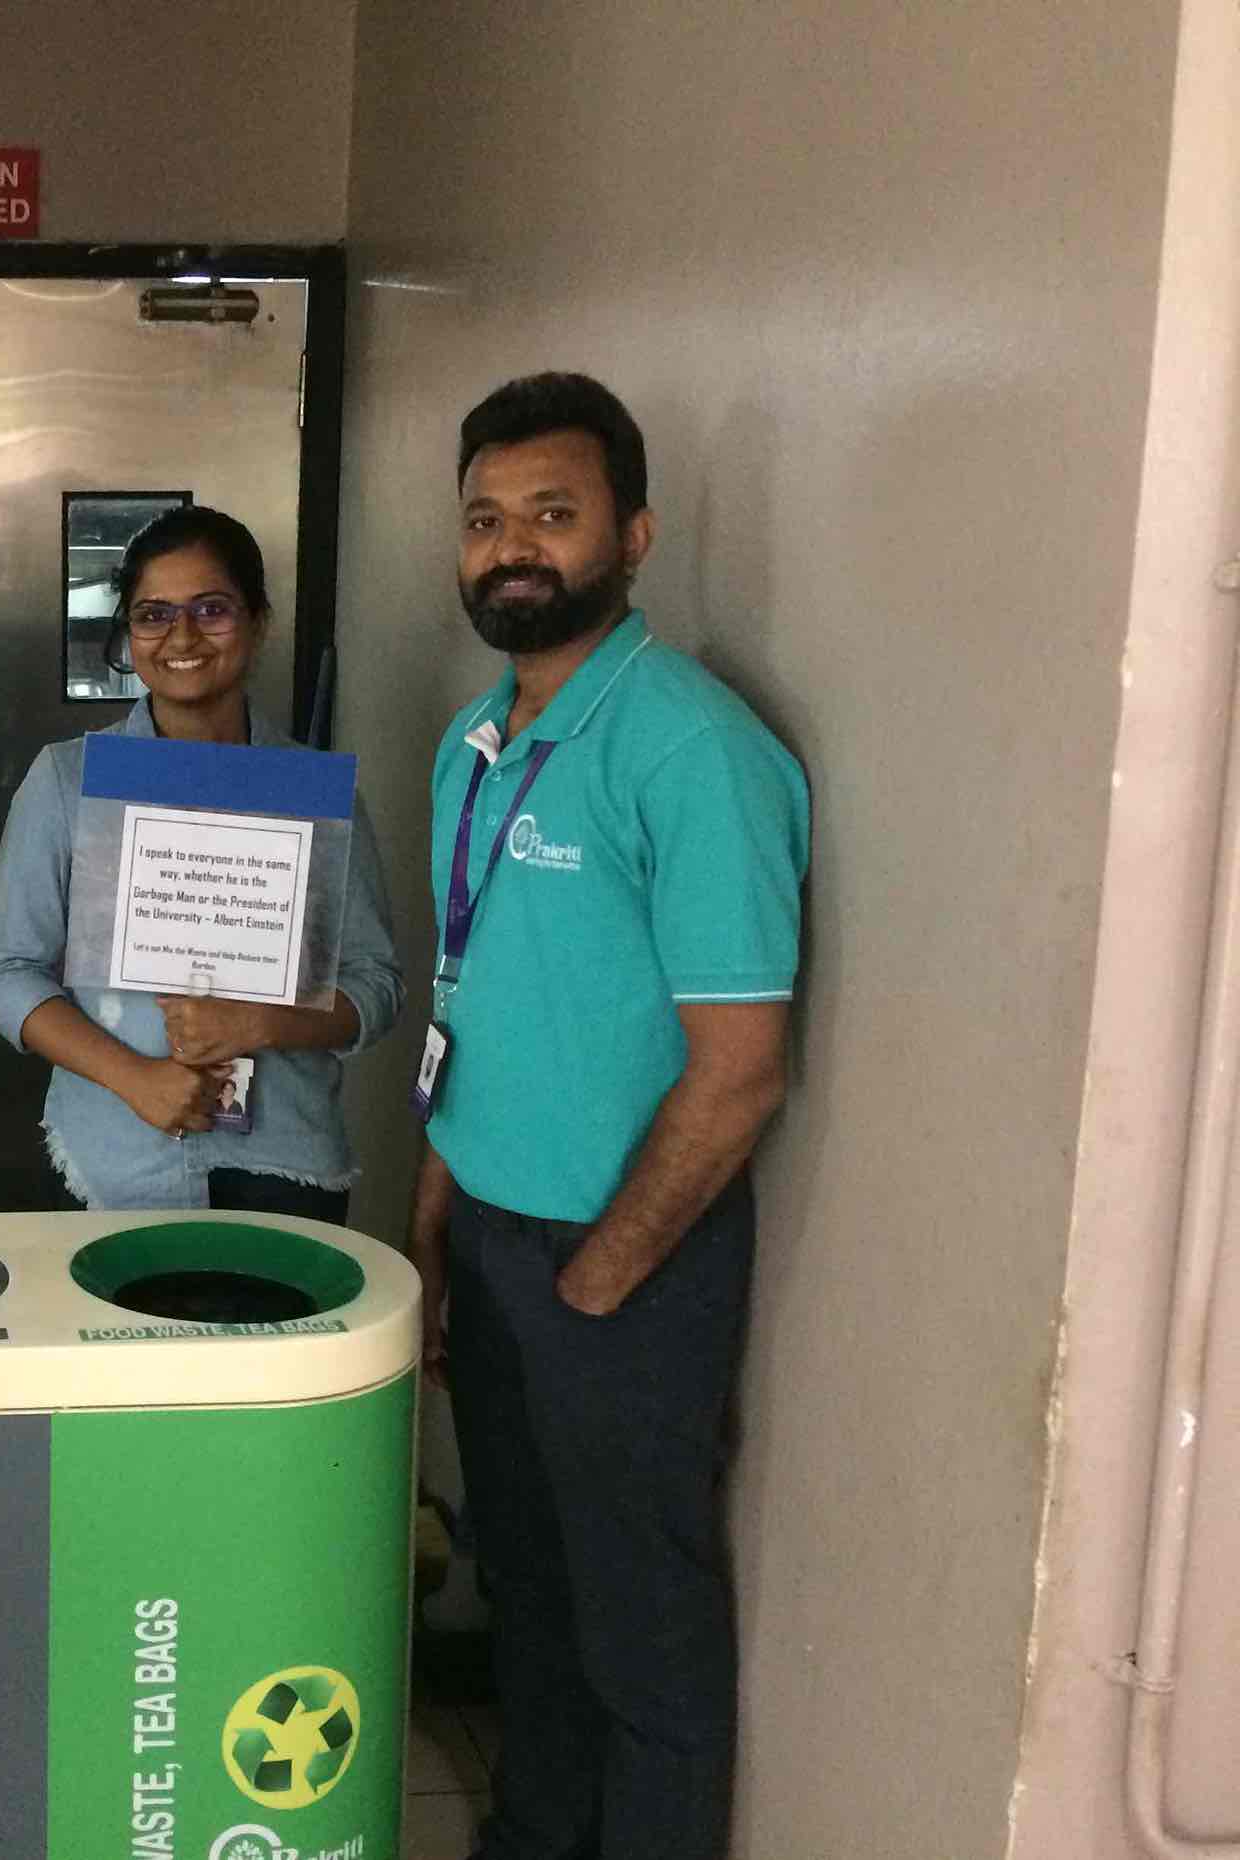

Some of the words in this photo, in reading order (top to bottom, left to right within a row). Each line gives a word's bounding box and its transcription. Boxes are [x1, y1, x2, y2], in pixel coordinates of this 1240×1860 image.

[145, 848, 173, 860] speak
[176, 849, 186, 861] to
[188, 853, 233, 866] everyone
[236, 854, 245, 866] in
[247, 856, 263, 869] the
[265, 859, 291, 871] same
[184, 870, 224, 884] whether
[226, 873, 237, 885] he
[240, 874, 250, 886] is
[252, 875, 267, 888] the
[133, 886, 173, 903] Garbage
[176, 891, 196, 904] Man
[198, 894, 210, 905] or
[212, 894, 228, 907] the
[230, 895, 277, 912] President
[279, 900, 290, 913] of
[135, 906, 151, 919] the
[153, 907, 202, 925] University
[213, 914, 244, 927] Albert
[246, 916, 284, 932] Einstein
[87, 1328, 146, 1340] FOOD
[239, 1323, 278, 1335] TEA
[280, 1320, 340, 1333] BAGS
[134, 1598, 179, 1684] BAGS
[133, 1692, 176, 1755] TEA
